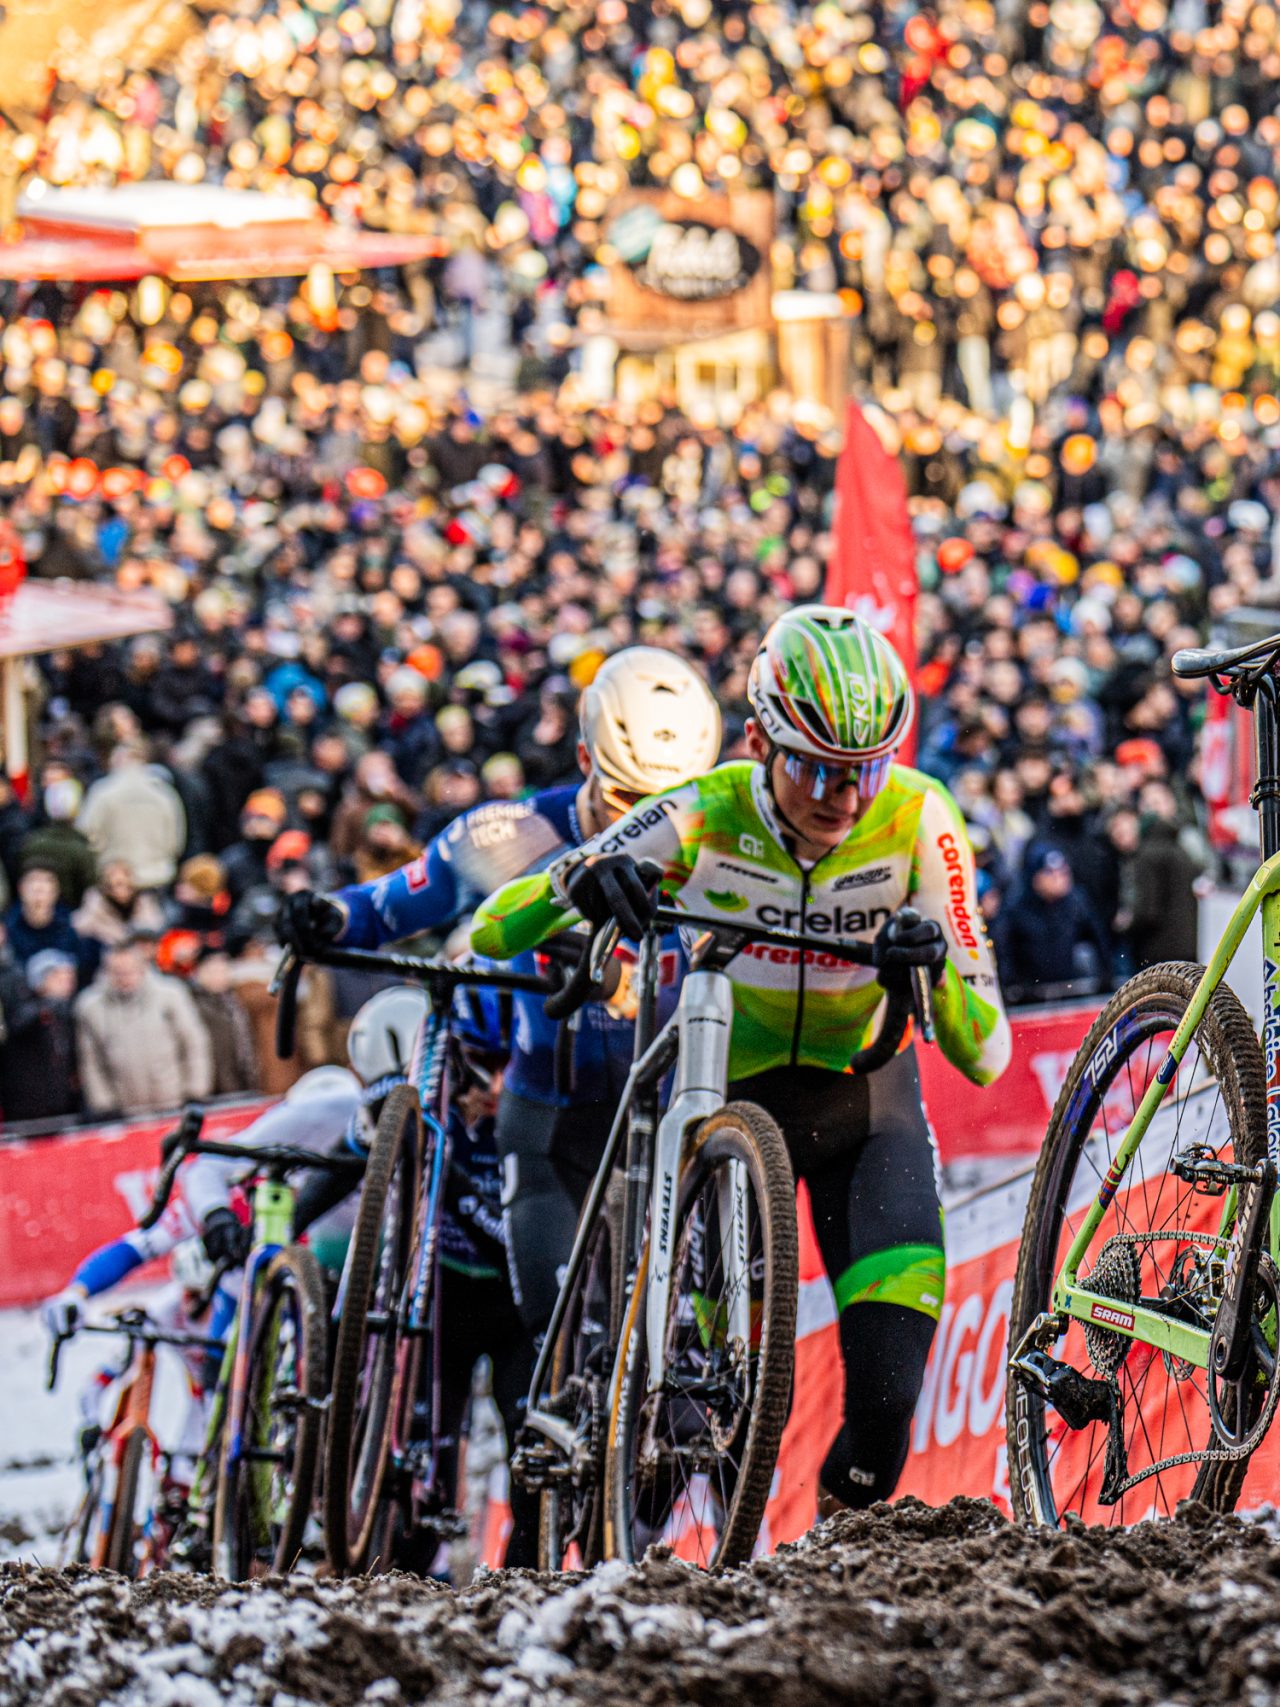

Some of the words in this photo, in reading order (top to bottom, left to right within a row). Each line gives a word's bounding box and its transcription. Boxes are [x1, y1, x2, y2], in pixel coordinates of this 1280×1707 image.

[601, 799, 678, 856] crelan
[936, 832, 979, 949] corendon
[755, 904, 892, 935] crelan
[658, 1171, 674, 1256] STEVENS
[1092, 1305, 1135, 1329] SRAM
